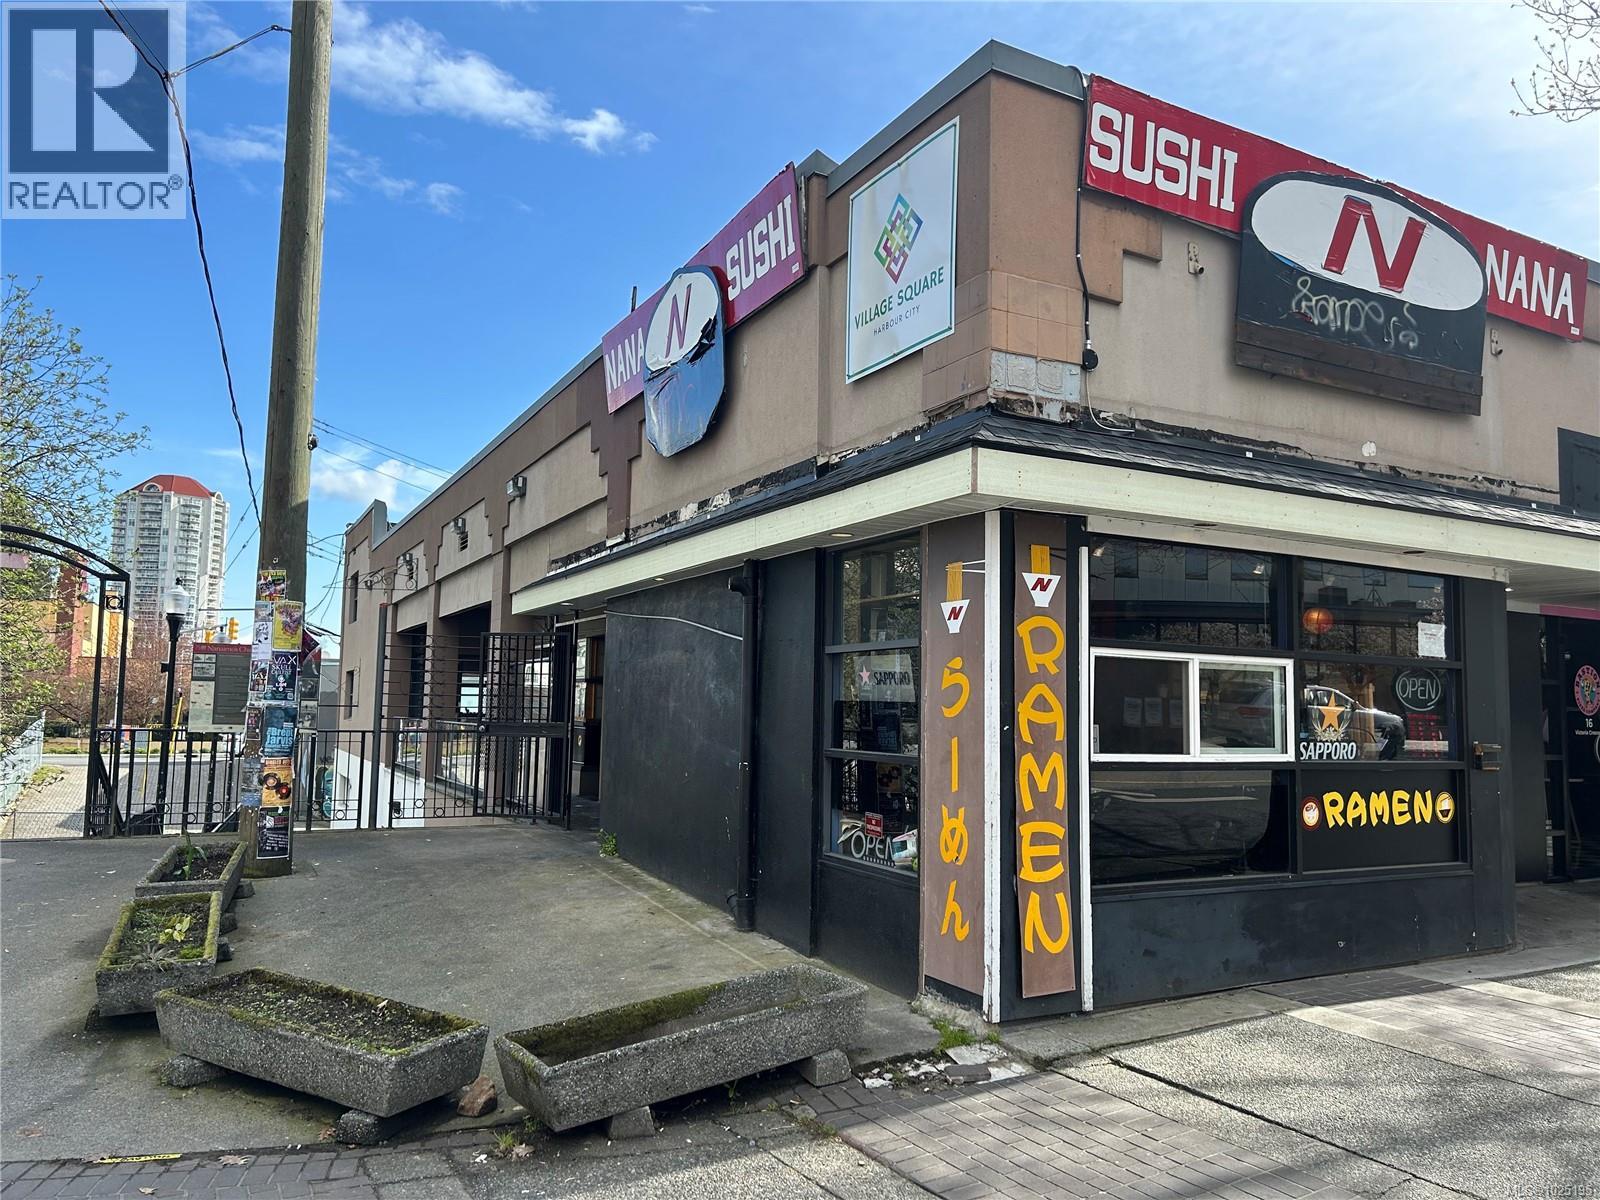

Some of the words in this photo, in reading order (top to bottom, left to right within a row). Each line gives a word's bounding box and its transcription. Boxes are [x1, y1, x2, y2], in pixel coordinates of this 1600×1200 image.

[1088, 101, 1238, 213] SUSHI
[725, 194, 797, 302] SUSHI
[1321, 193, 1428, 294] N
[854, 295, 894, 330] VILLAGE
[897, 266, 945, 307] SQUARE
[1486, 243, 1576, 325] NANA
[665, 283, 693, 359] N
[873, 313, 903, 337] HARBOUR
[904, 304, 921, 324] CITY
[604, 326, 645, 394] NANA
[1030, 577, 1053, 592] N
[947, 605, 964, 621] N
[873, 671, 911, 686] SAPPORO
[1399, 676, 1438, 701] OPEN
[266, 735, 294, 746] Jarvis
[1585, 718, 1594, 729] 16
[1299, 741, 1357, 761] SAPPORO
[939, 656, 971, 942] らーめん
[1016, 615, 1071, 954] RAMEN
[1322, 789, 1433, 829] RAMEN
